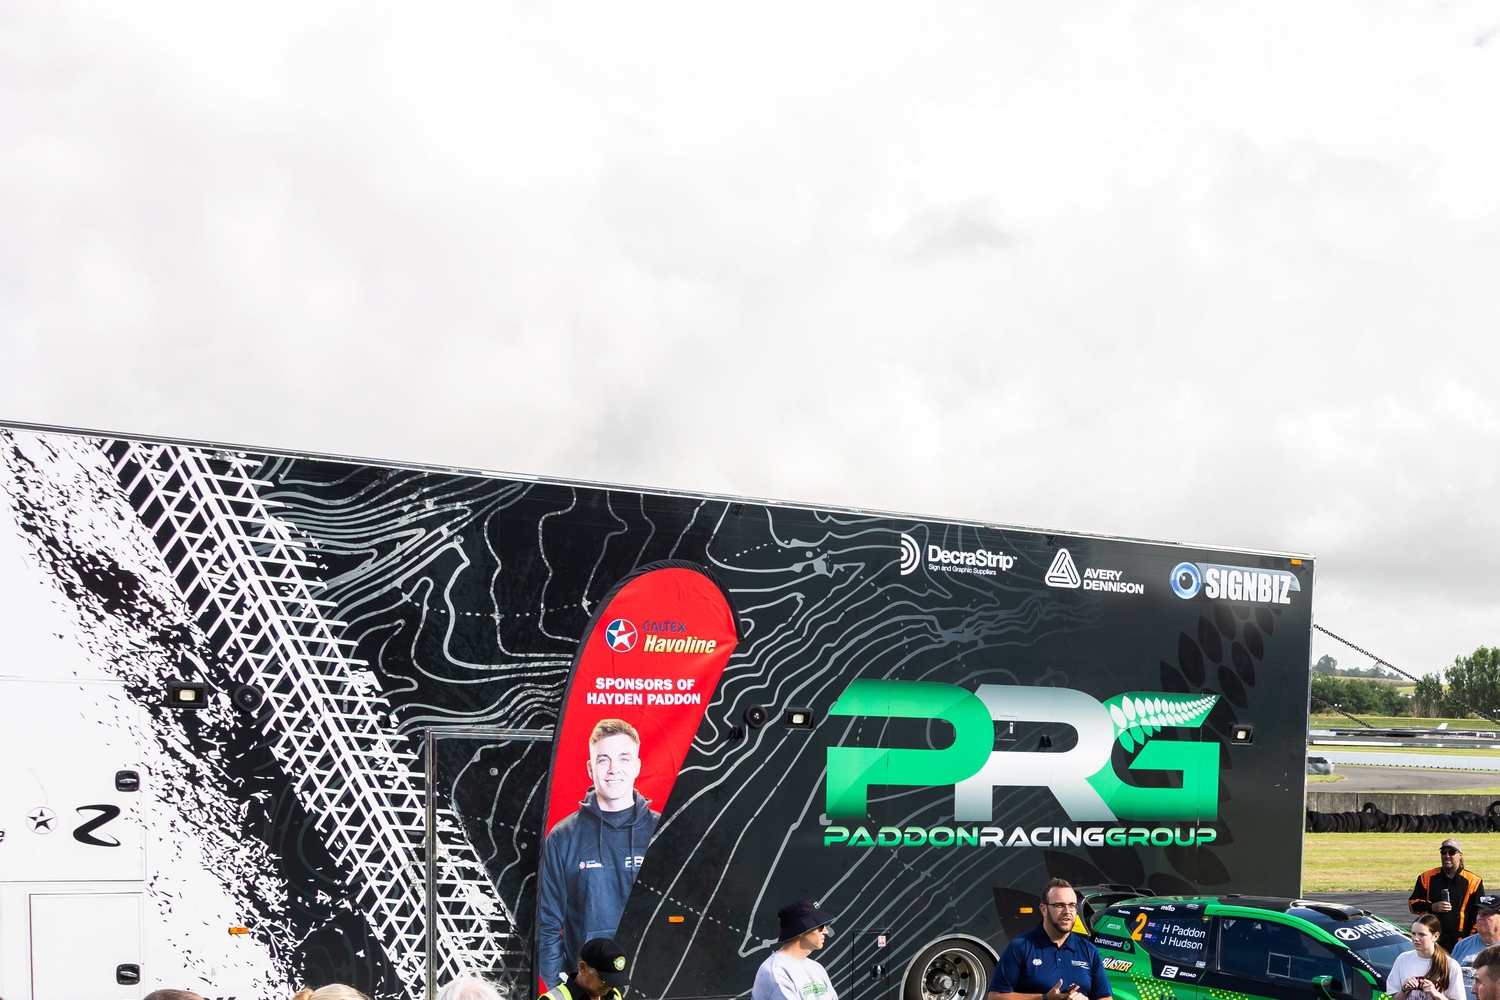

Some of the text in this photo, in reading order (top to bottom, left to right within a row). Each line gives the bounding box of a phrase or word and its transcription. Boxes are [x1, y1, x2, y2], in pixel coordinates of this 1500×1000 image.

[928, 545, 1013, 571] DecraStrip
[952, 566, 973, 574] Graphic
[1084, 567, 1124, 581] AVERY
[1083, 580, 1144, 594] DENNISON
[1205, 569, 1291, 604] SIGNBIZ
[643, 621, 686, 632] CALTEX
[643, 634, 717, 654] Havoline
[595, 678, 695, 690] SPONSORS OF
[587, 693, 701, 705] HAYDEN PADDON
[826, 678, 1221, 822] PRG
[1132, 913, 1147, 941] 2
[1161, 924, 1206, 938] H Paddon
[1094, 937, 1123, 948] bartercard
[1160, 936, 1203, 950] J Hudson
